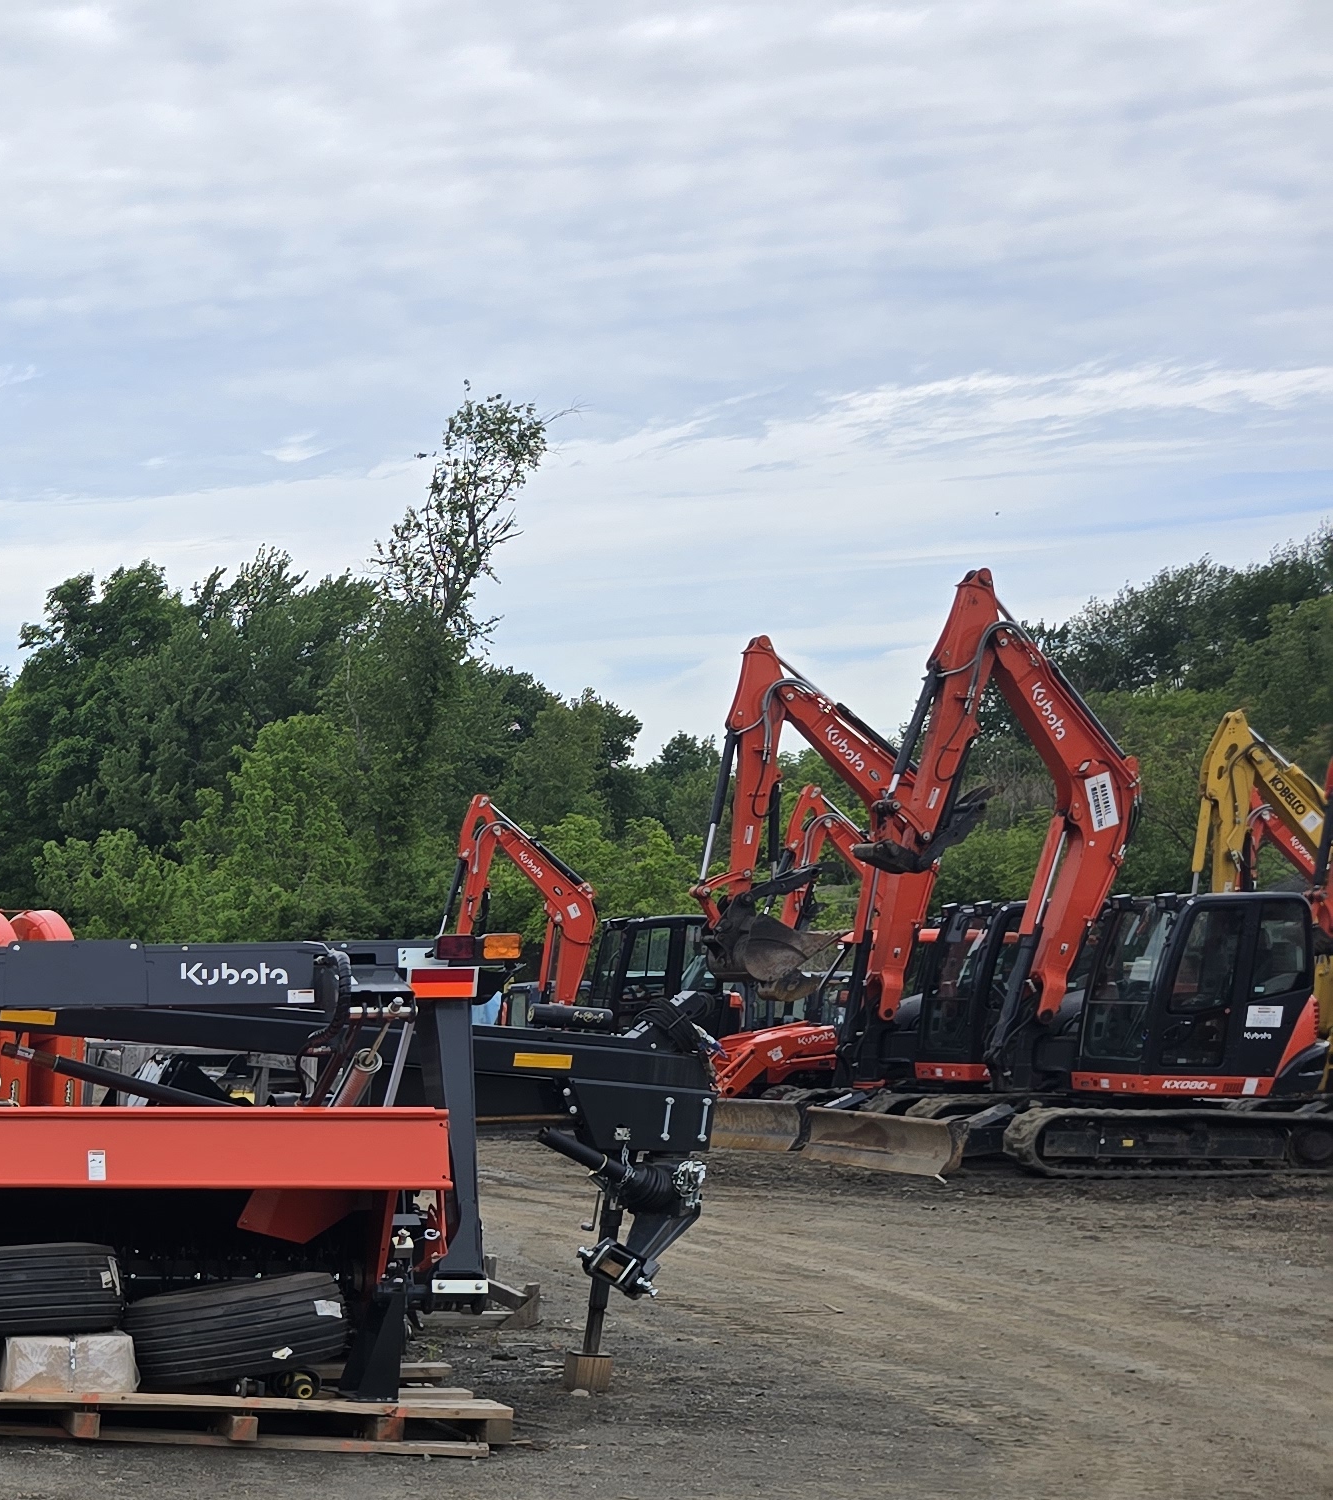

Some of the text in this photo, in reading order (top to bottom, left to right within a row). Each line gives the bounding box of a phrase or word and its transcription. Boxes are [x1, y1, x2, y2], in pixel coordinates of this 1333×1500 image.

[1031, 681, 1066, 741] Kubota
[824, 723, 865, 772] Kubota
[1268, 774, 1307, 815] KOBELCO
[519, 851, 543, 878] Kubota
[180, 962, 289, 986] Kubota
[797, 1031, 836, 1046] Kubota
[1243, 1031, 1272, 1040] Kubota
